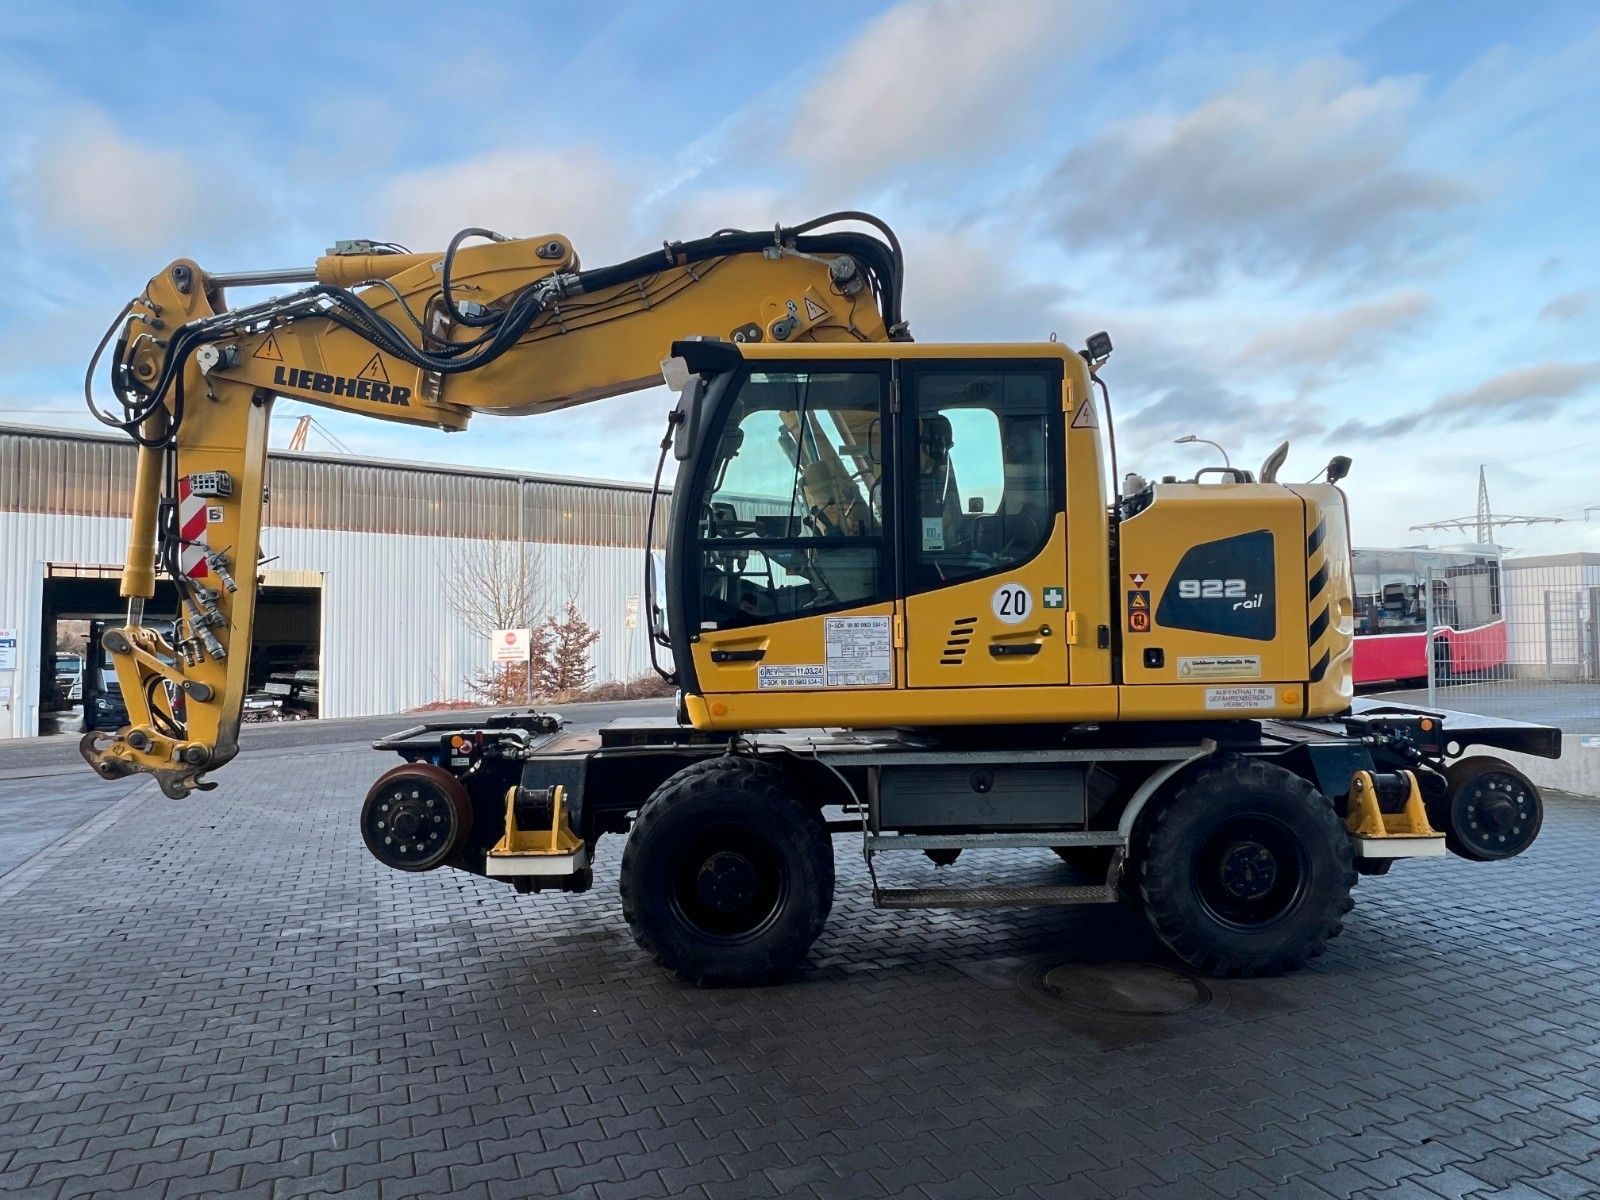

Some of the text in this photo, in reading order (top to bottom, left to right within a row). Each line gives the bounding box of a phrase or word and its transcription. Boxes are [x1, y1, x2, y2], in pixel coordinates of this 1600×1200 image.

[274, 366, 411, 406] LIEBHERR
[1179, 579, 1247, 599] 922
[1000, 590, 1026, 615] 20
[1233, 594, 1263, 610] rail
